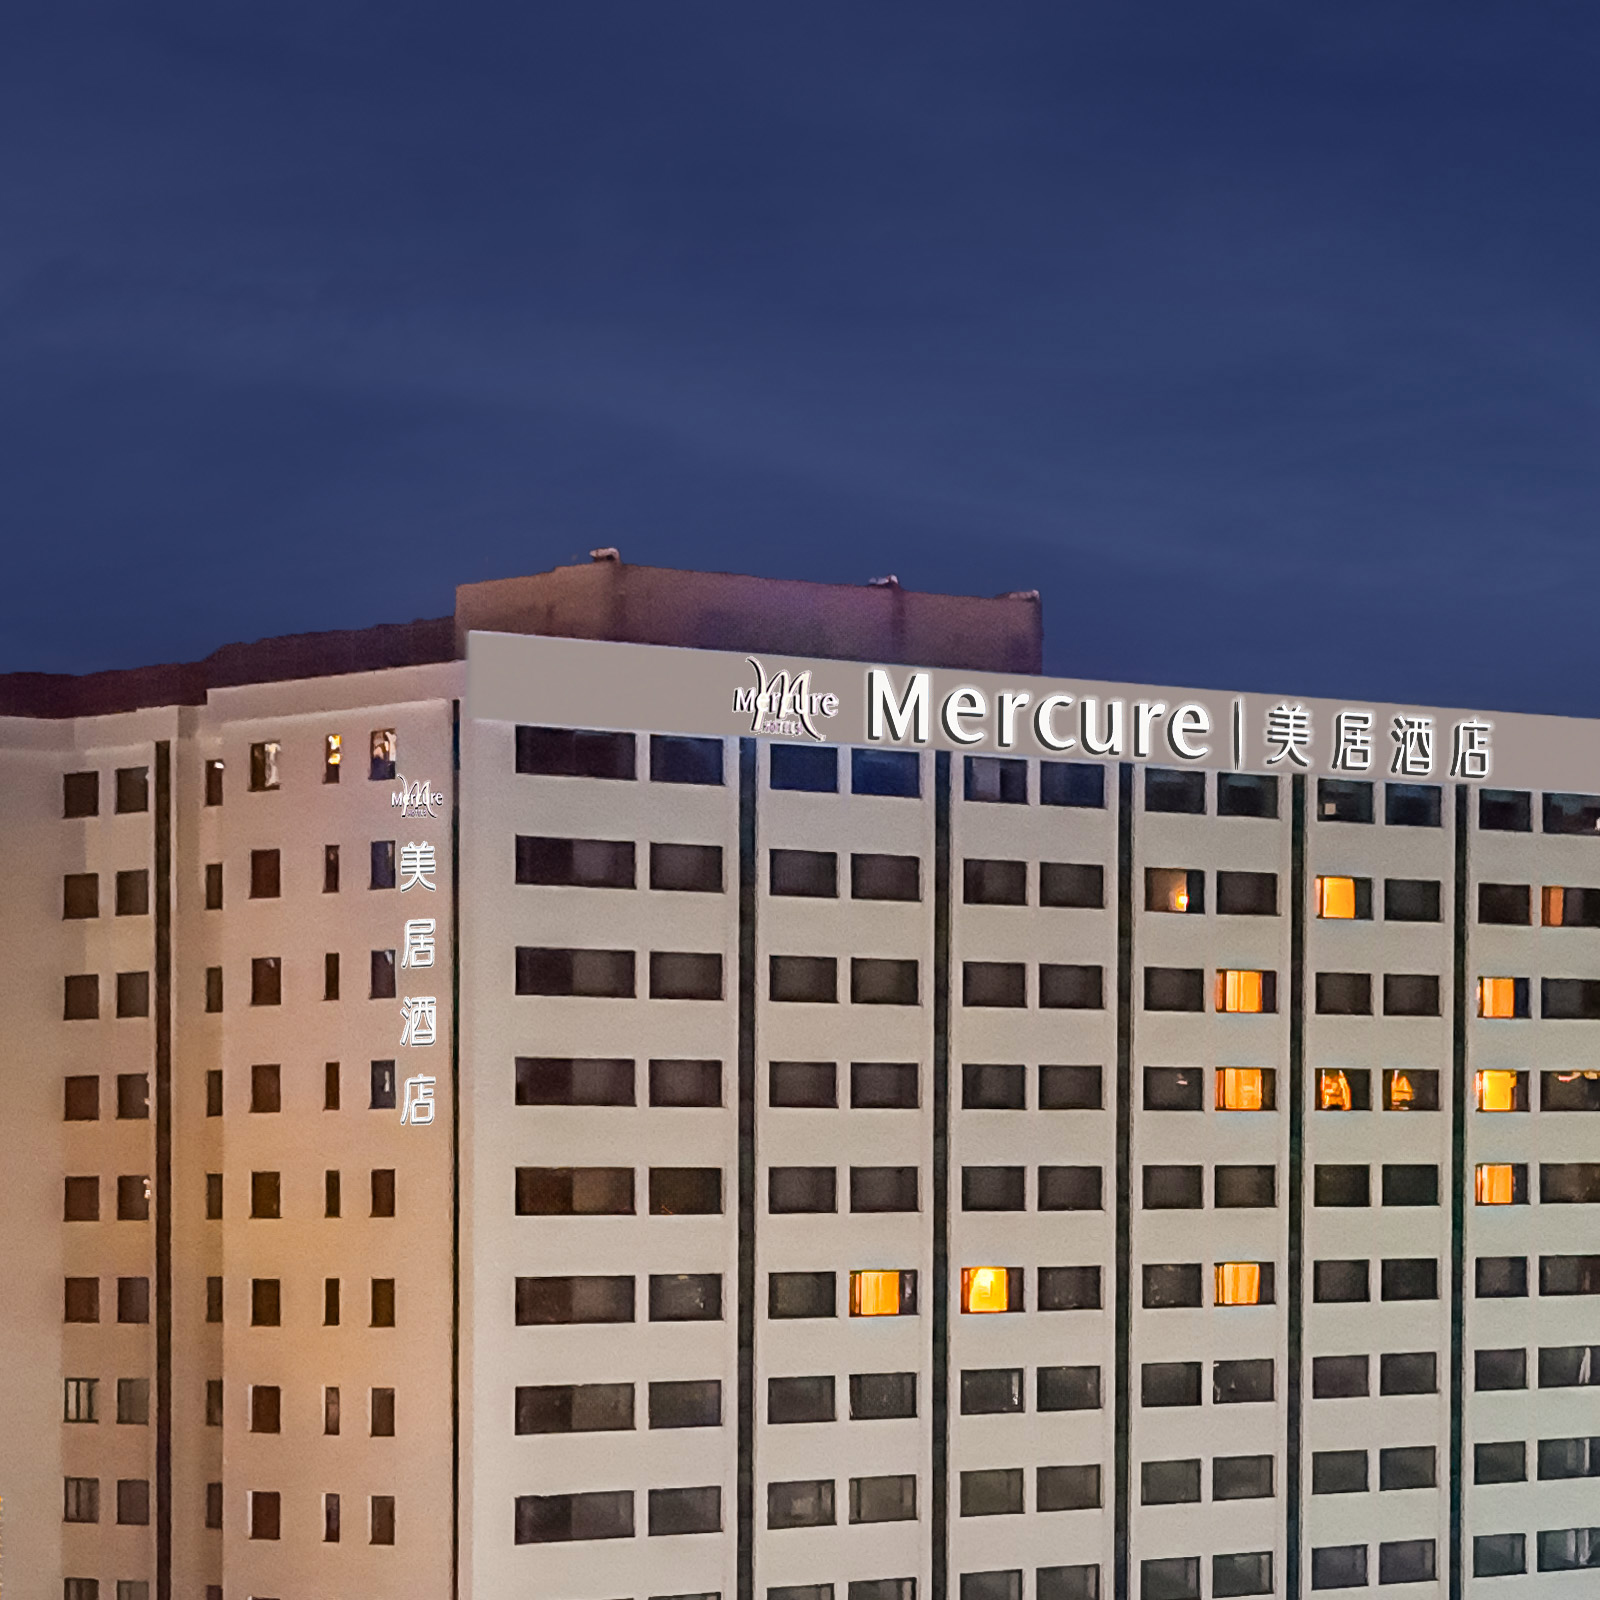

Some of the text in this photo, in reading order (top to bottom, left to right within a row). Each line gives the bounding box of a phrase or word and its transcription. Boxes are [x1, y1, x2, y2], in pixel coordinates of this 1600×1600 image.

[867, 668, 1492, 778] Mercure 美居酒店
[400, 842, 437, 1126] 美居酒店
